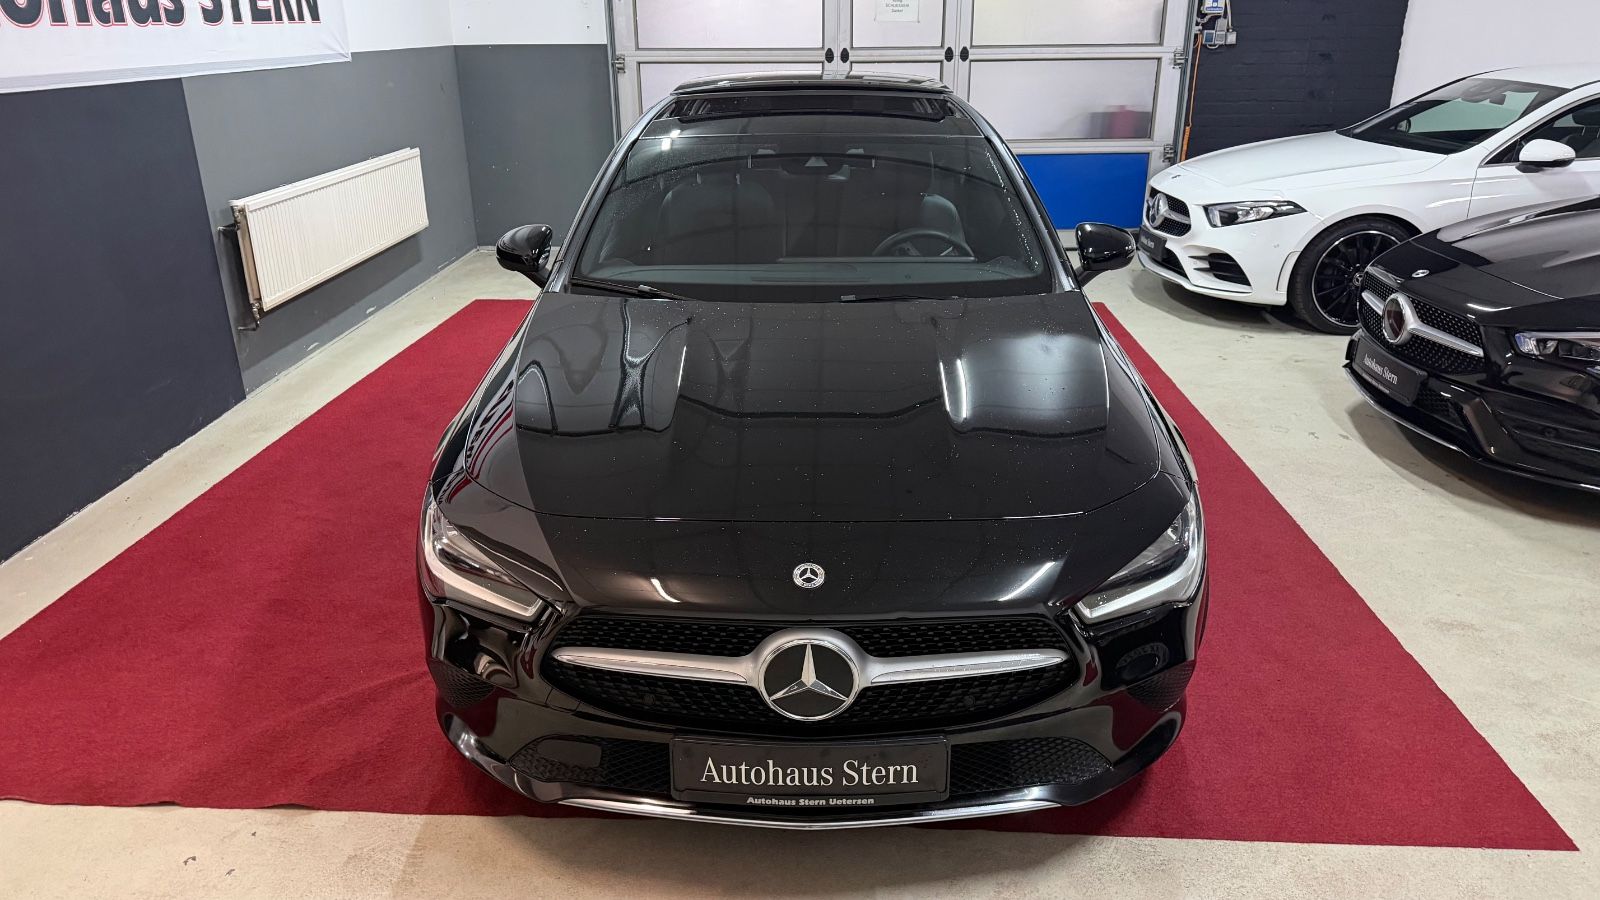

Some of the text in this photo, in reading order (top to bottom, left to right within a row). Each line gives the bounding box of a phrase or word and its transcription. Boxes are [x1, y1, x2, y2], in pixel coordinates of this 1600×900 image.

[1383, 366, 1398, 385] Stern
[700, 756, 919, 786] Autohaus Stern
[746, 796, 796, 806] Autohaus
[799, 798, 826, 806] Stern
